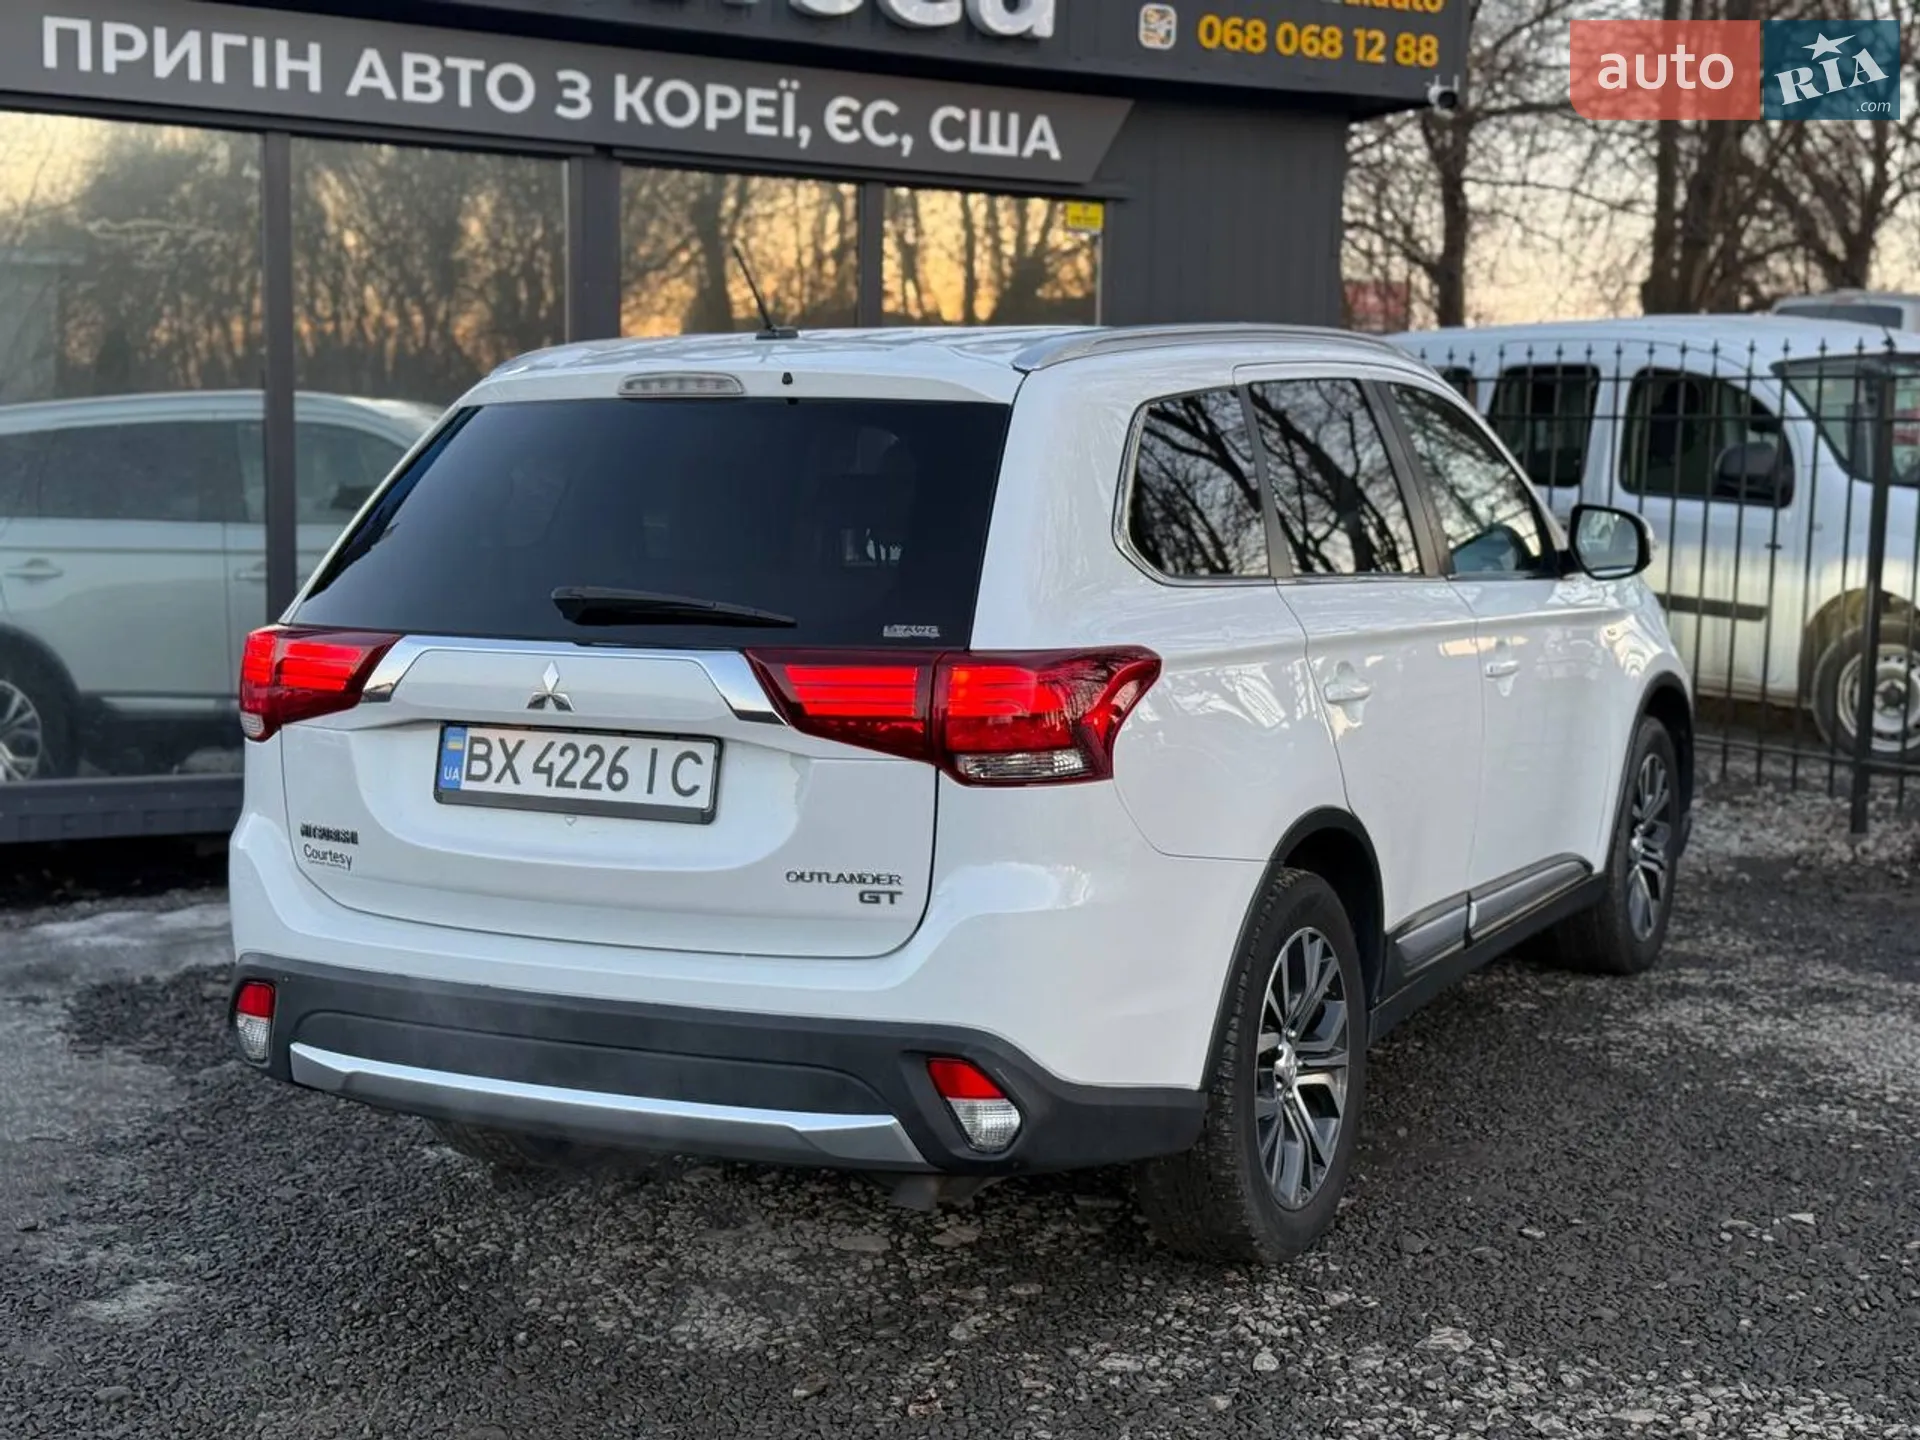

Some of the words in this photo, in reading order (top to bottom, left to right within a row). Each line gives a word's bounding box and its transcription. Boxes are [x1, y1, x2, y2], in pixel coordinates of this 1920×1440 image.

[1197, 14, 1267, 53] 068
[1275, 21, 1344, 60] 068
[1352, 28, 1387, 64] 12
[1394, 33, 1440, 68] 88
[42, 15, 322, 93] ПРИГІН
[346, 47, 536, 113] АВТО
[614, 73, 812, 149] КОРЕЇ,
[823, 96, 914, 157] ЄС,
[928, 105, 1062, 161] США
[443, 766, 461, 781] UA
[465, 735, 526, 785] BX
[532, 741, 630, 792] 4226
[303, 843, 353, 872] Courtesy
[785, 870, 902, 886] OUTLANDER
[858, 889, 904, 905] GT
